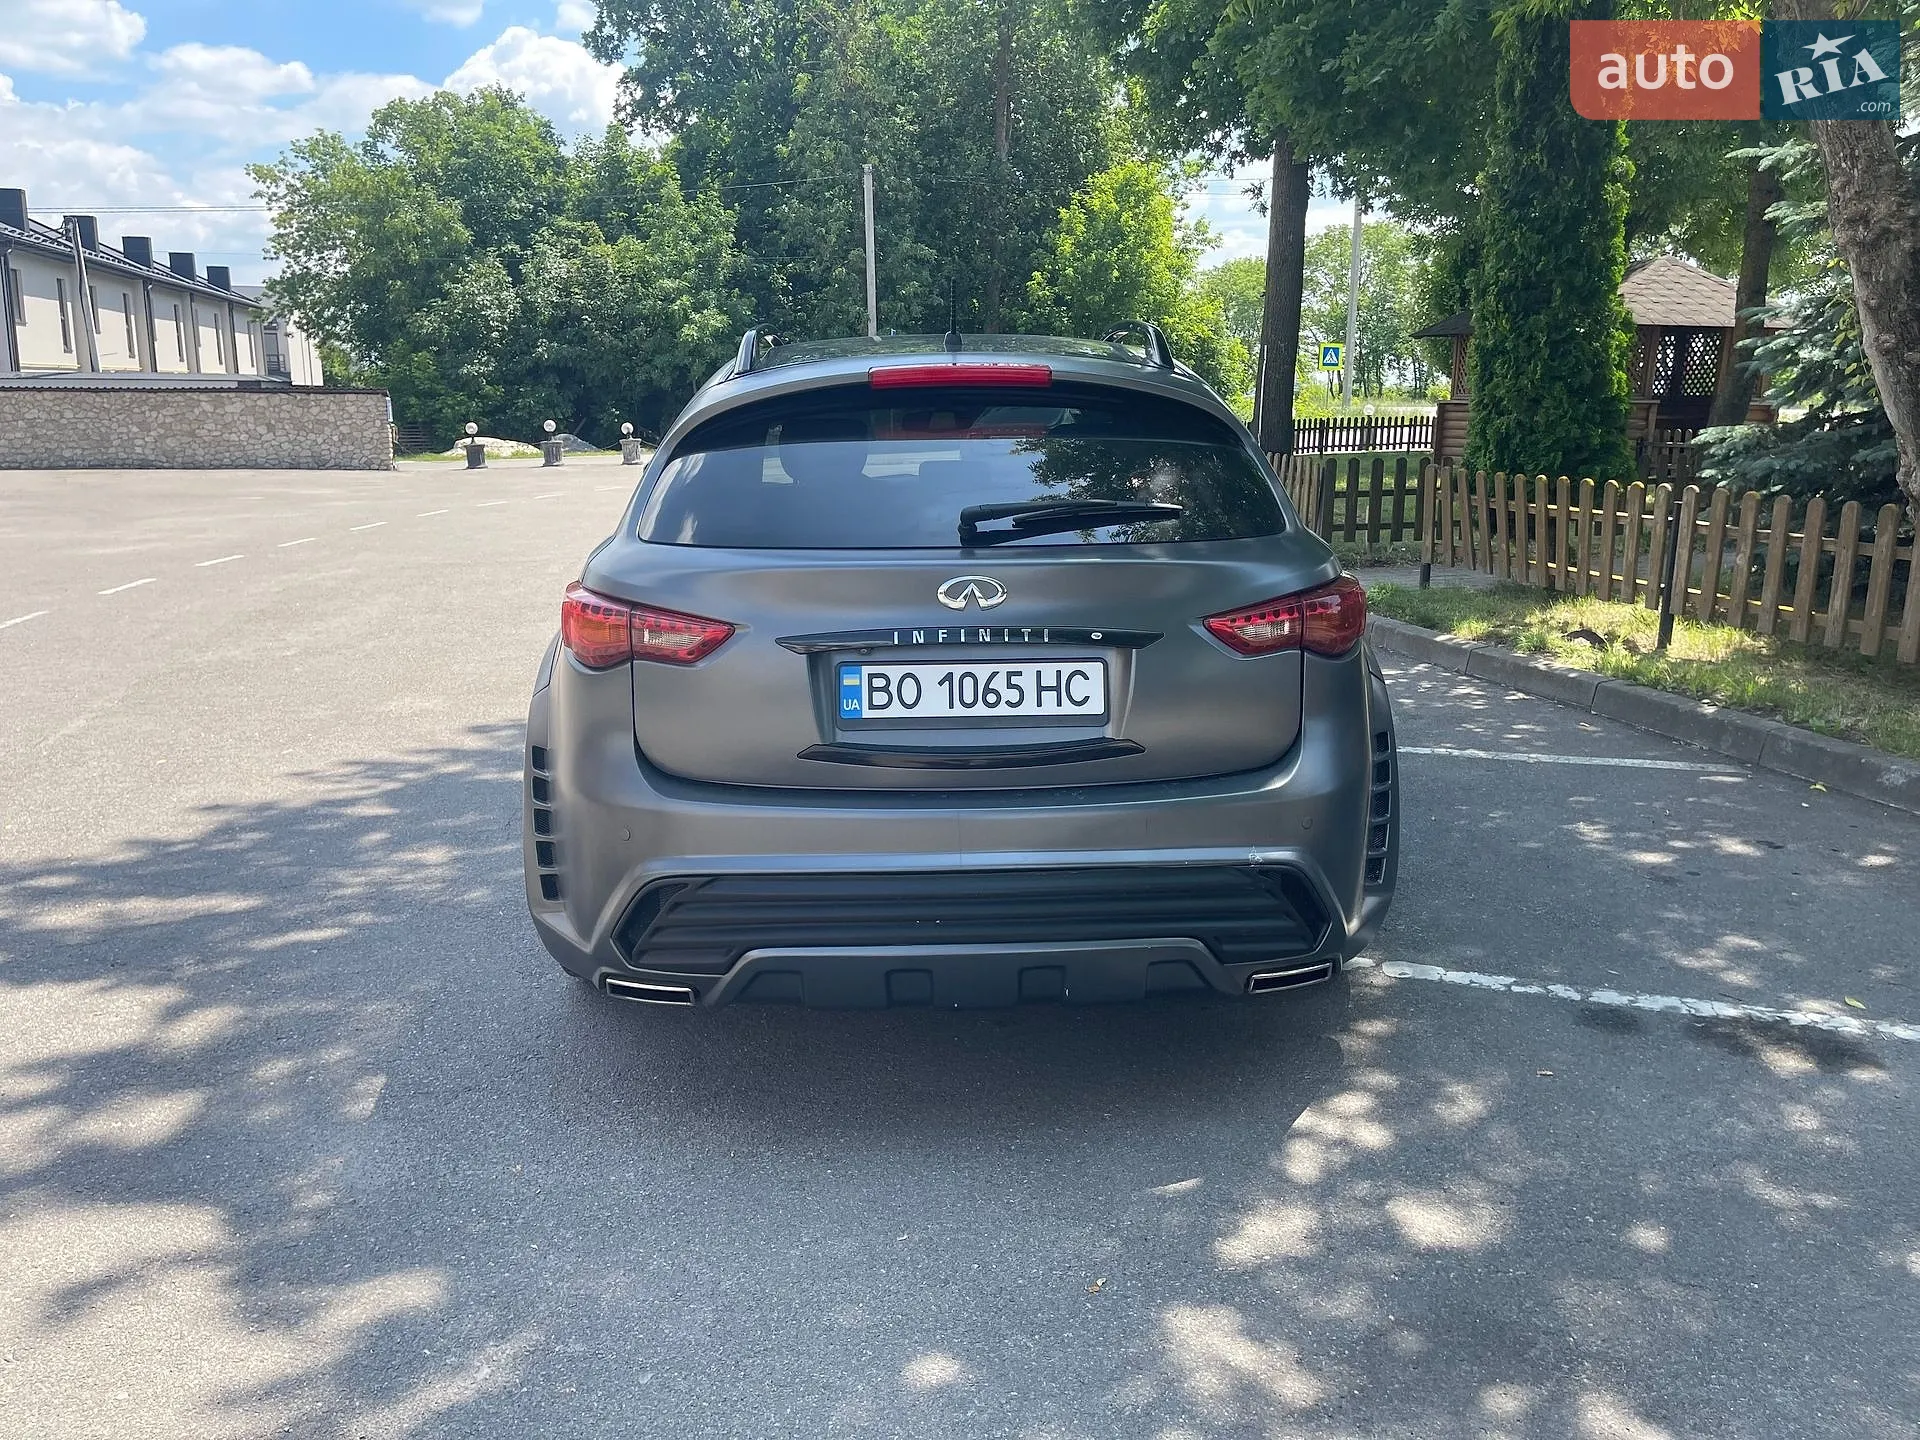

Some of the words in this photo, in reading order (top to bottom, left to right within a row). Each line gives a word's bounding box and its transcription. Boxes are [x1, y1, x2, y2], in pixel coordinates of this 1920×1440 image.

[893, 628, 1049, 645] INFINITI
[867, 672, 922, 710] BO
[937, 671, 1025, 709] 1065
[1036, 670, 1091, 707] HC
[843, 699, 860, 711] UA
